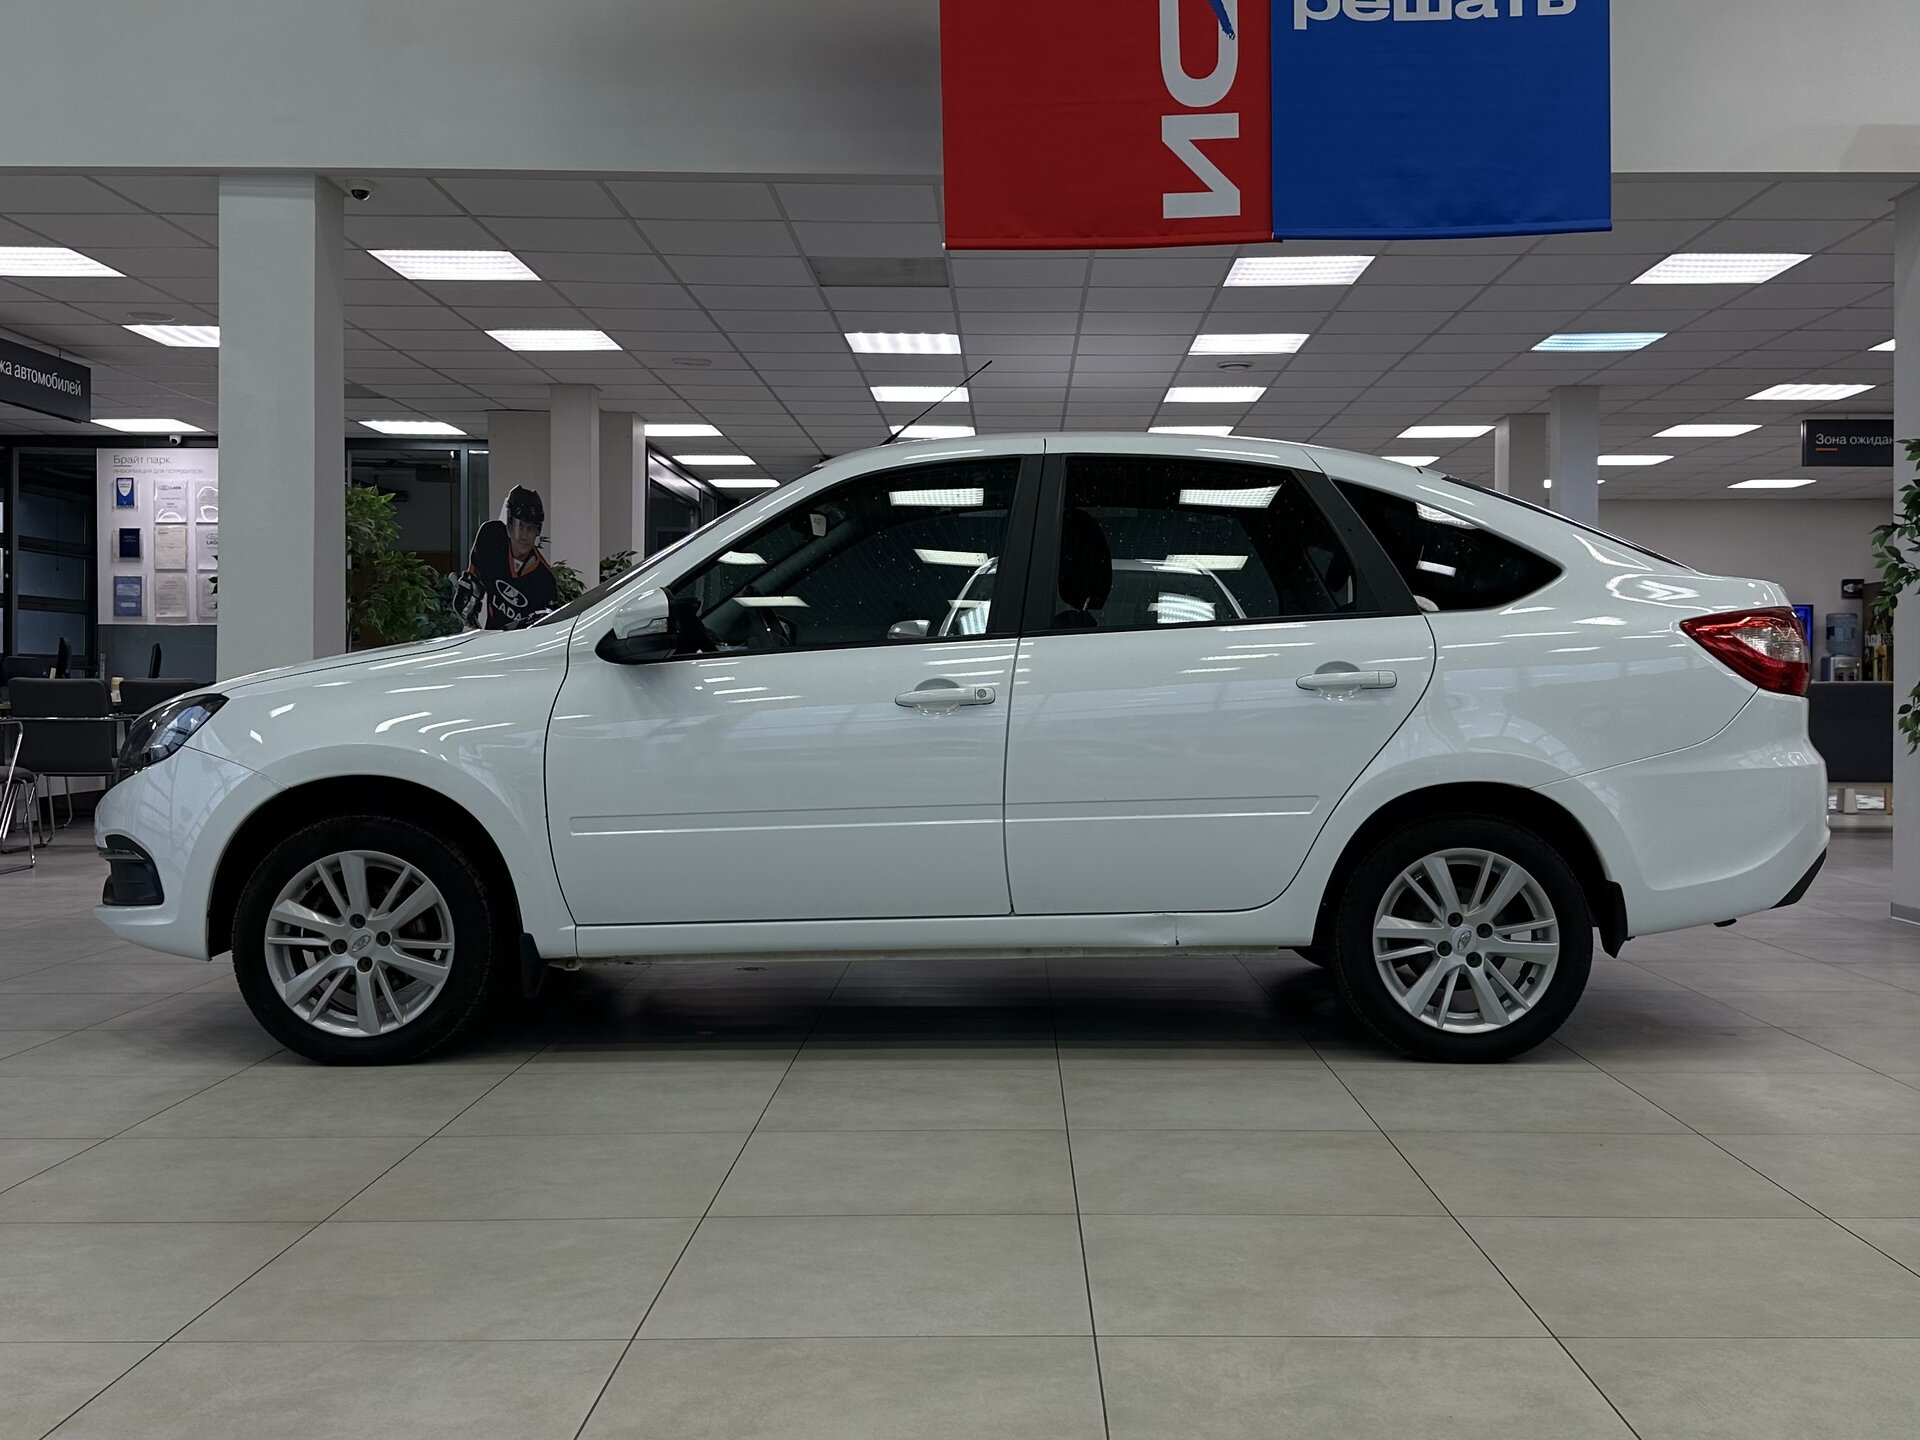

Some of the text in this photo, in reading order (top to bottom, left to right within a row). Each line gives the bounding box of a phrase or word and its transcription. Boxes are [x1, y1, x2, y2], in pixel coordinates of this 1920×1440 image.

[14, 364, 82, 397] автомобилей
[1815, 433, 1847, 445] Зона
[113, 455, 144, 465] Брайт
[492, 594, 522, 621] LADA
